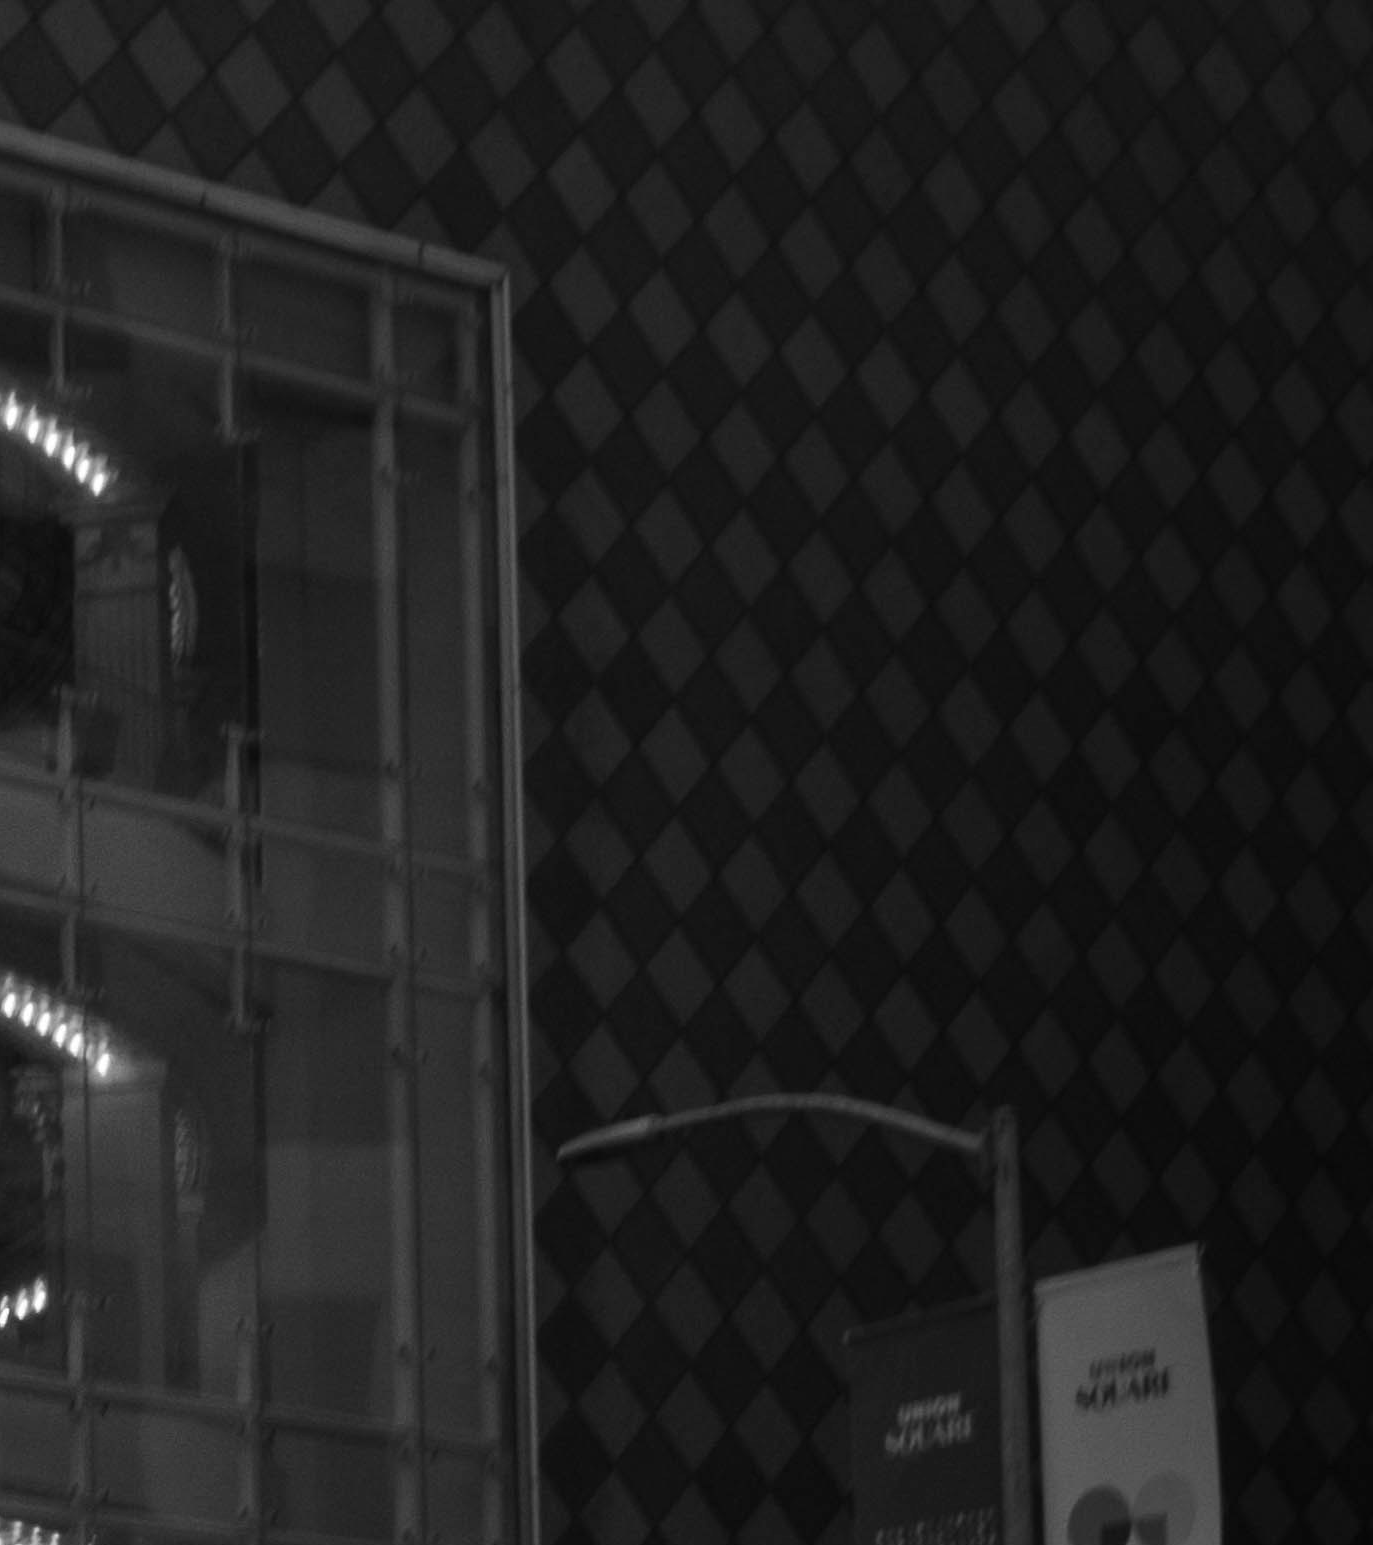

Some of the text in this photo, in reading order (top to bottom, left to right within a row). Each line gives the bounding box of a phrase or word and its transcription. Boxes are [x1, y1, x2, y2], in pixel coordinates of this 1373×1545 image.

[1088, 1347, 1156, 1381] UNION
[896, 1390, 963, 1427] UNION
[1075, 1365, 1170, 1411] SQUARE
[884, 1411, 973, 1457] SQUARE
